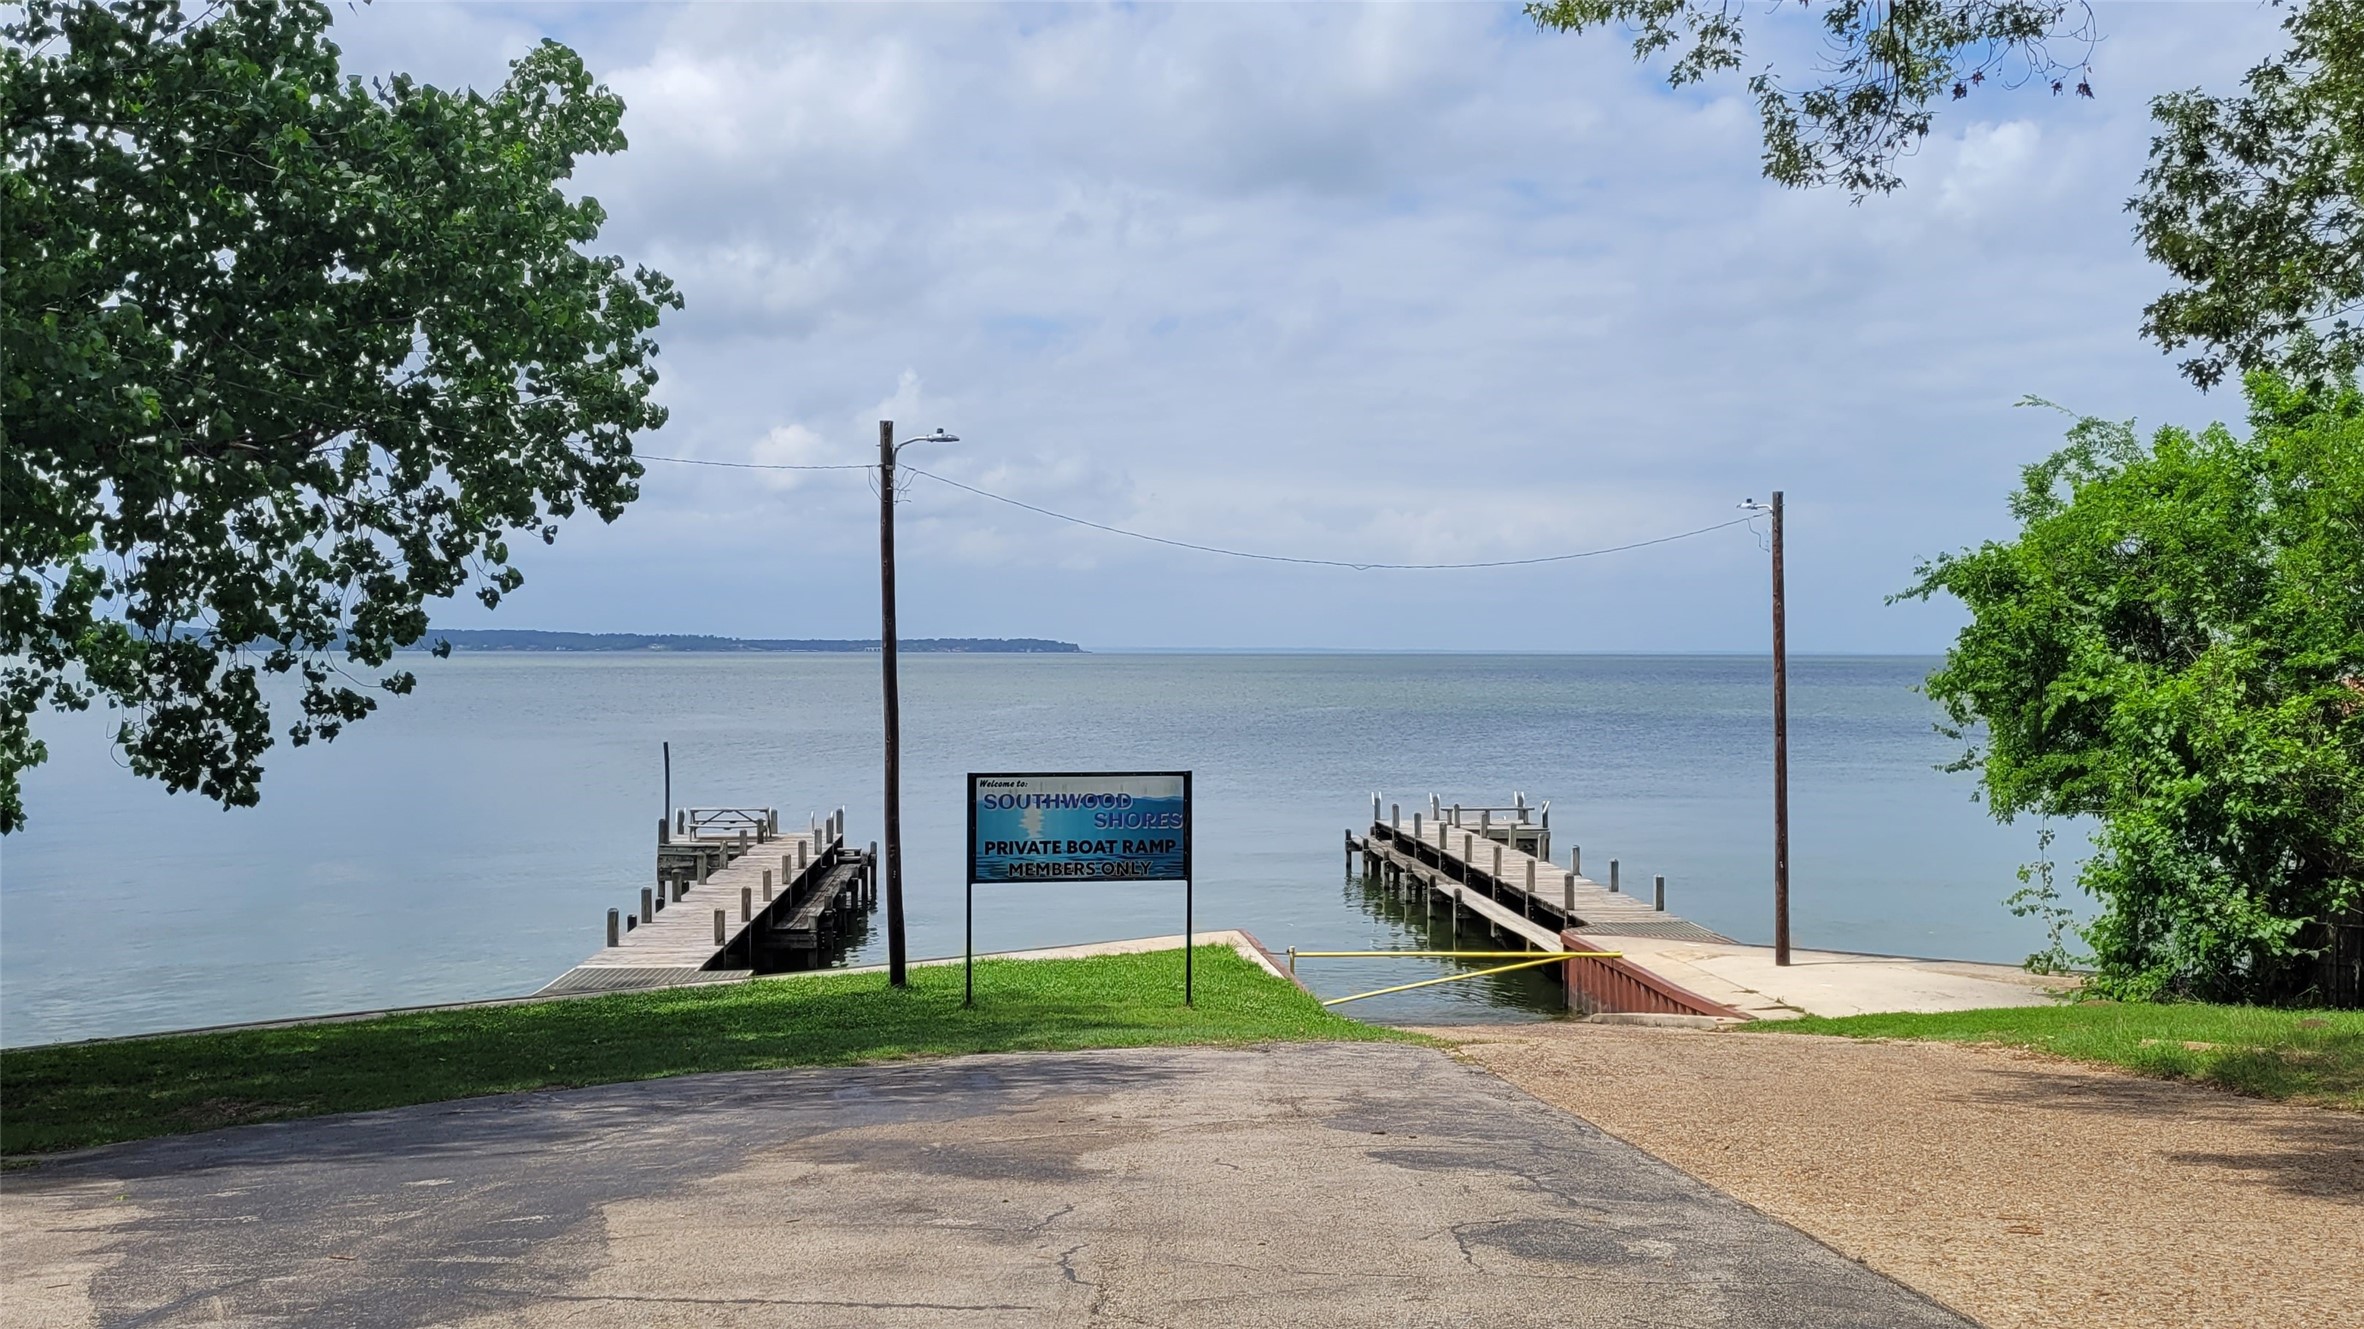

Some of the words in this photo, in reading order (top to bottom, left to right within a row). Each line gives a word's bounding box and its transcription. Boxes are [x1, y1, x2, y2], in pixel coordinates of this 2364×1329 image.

[979, 779, 1015, 788] Welcome
[1016, 779, 1028, 788] to:
[983, 793, 1133, 810] SOUTHWOOD
[1094, 812, 1184, 829] SHORES
[984, 840, 1062, 855] PRIVATE
[1067, 839, 1118, 854] BOAT
[1122, 839, 1176, 854] RAMP
[1008, 862, 1096, 877] MEMBERS
[1101, 861, 1152, 876] ONLY
